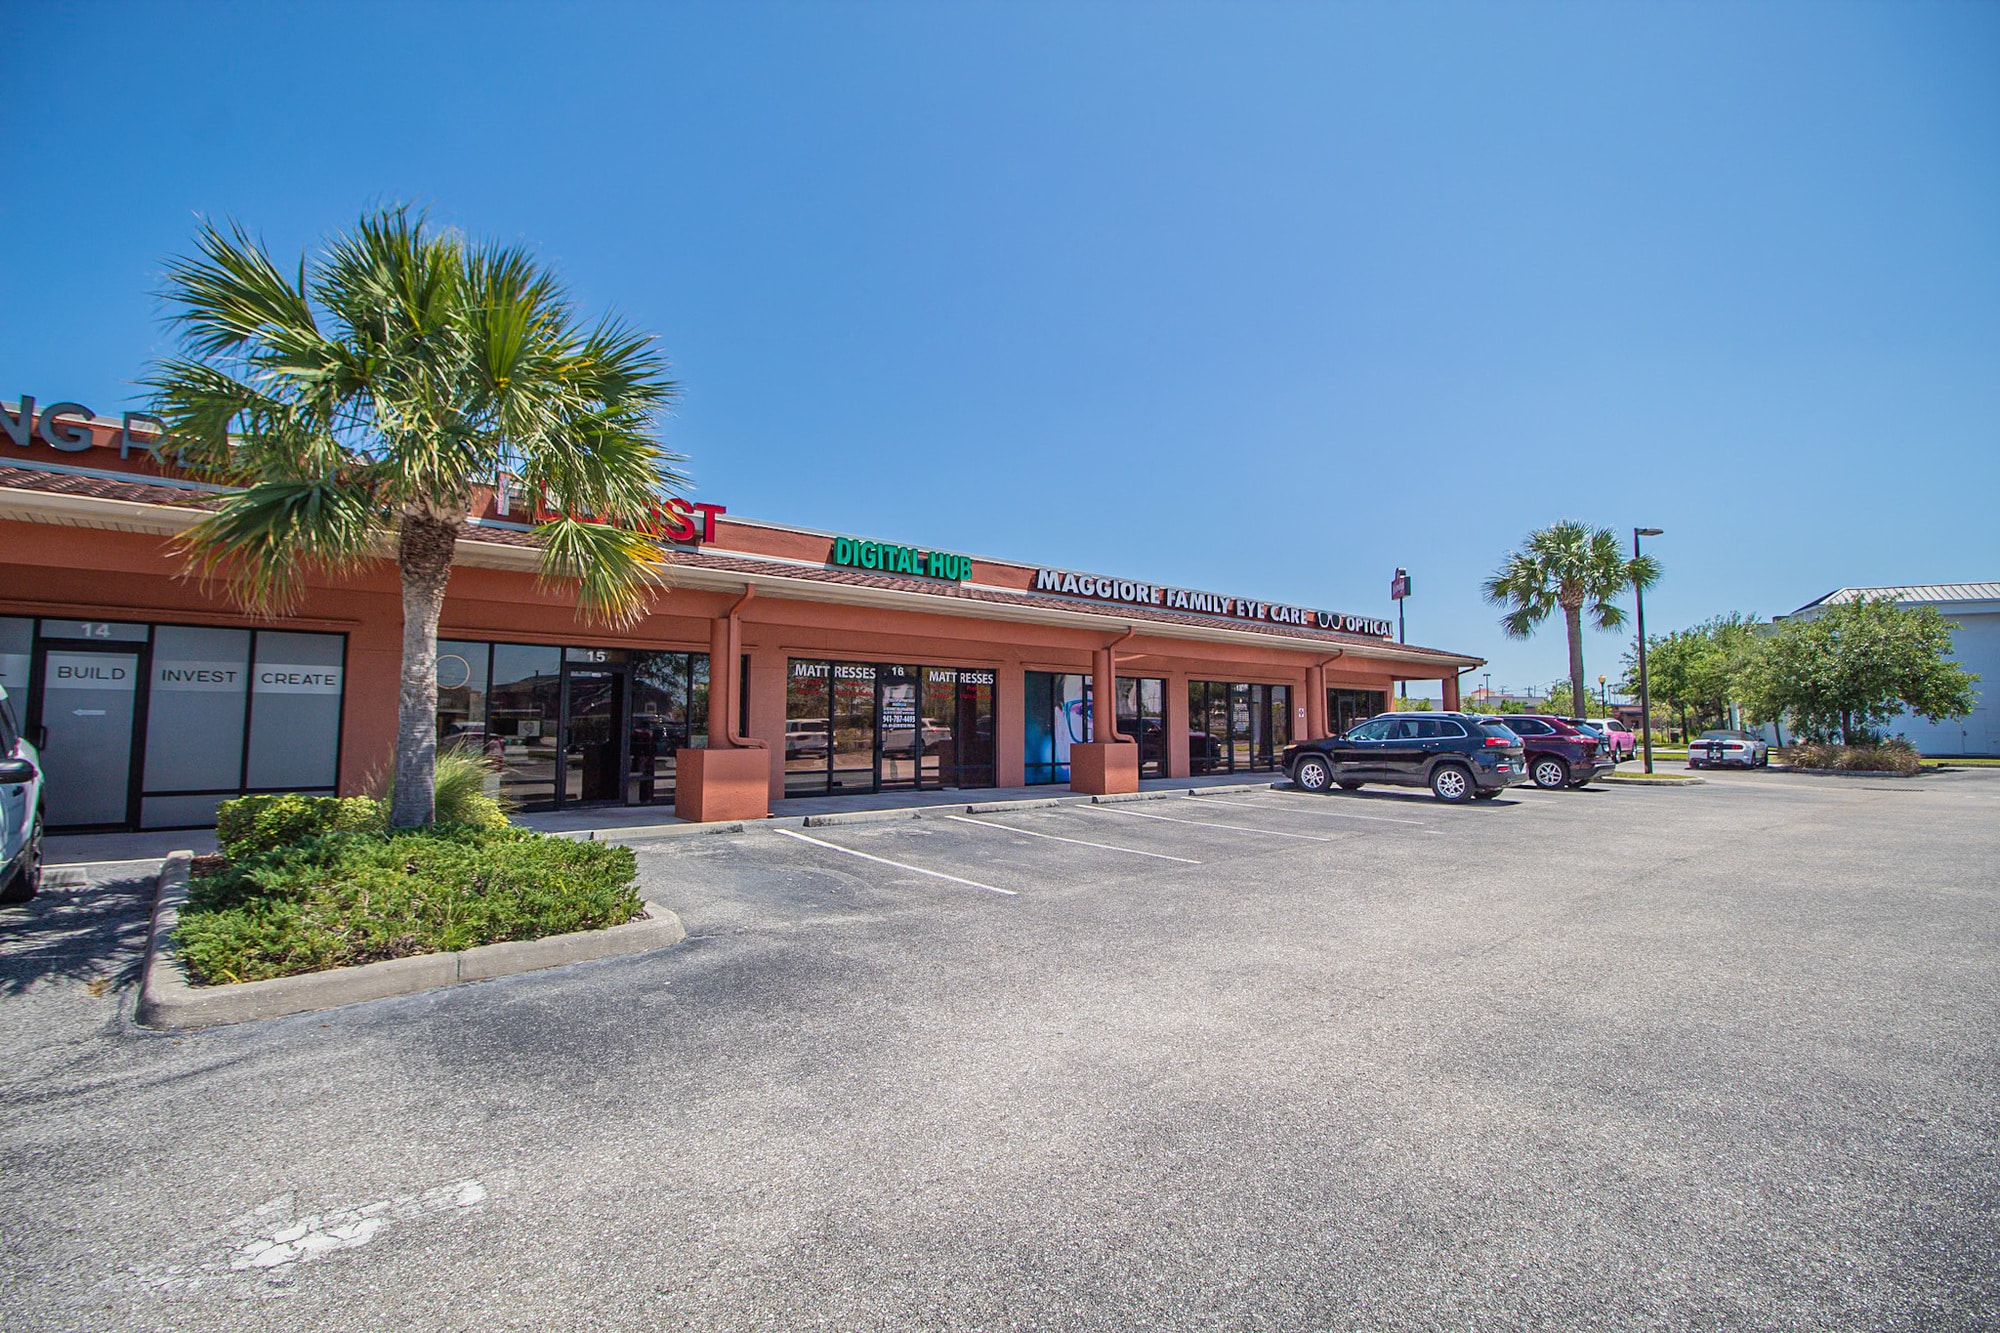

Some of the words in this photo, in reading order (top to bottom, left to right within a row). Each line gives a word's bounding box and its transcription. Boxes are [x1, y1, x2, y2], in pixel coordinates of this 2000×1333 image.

[833, 536, 925, 576] DIGITAL
[928, 551, 973, 581] HUB
[1036, 568, 1160, 604] MAGGIORE
[1167, 588, 1231, 614] FAMILY
[1236, 599, 1266, 619] EYE
[1270, 605, 1309, 625] CARE
[1345, 616, 1395, 637] OPTICAL
[81, 623, 111, 639] 14
[587, 650, 607, 663] 15
[57, 666, 126, 681] BUILD
[162, 669, 238, 684] INVEST
[795, 664, 831, 677] MATT
[834, 666, 877, 680] RESSES
[891, 666, 905, 677] 16
[929, 671, 958, 683] MATT
[960, 673, 994, 685] RESSES
[261, 672, 337, 687] CREATE
